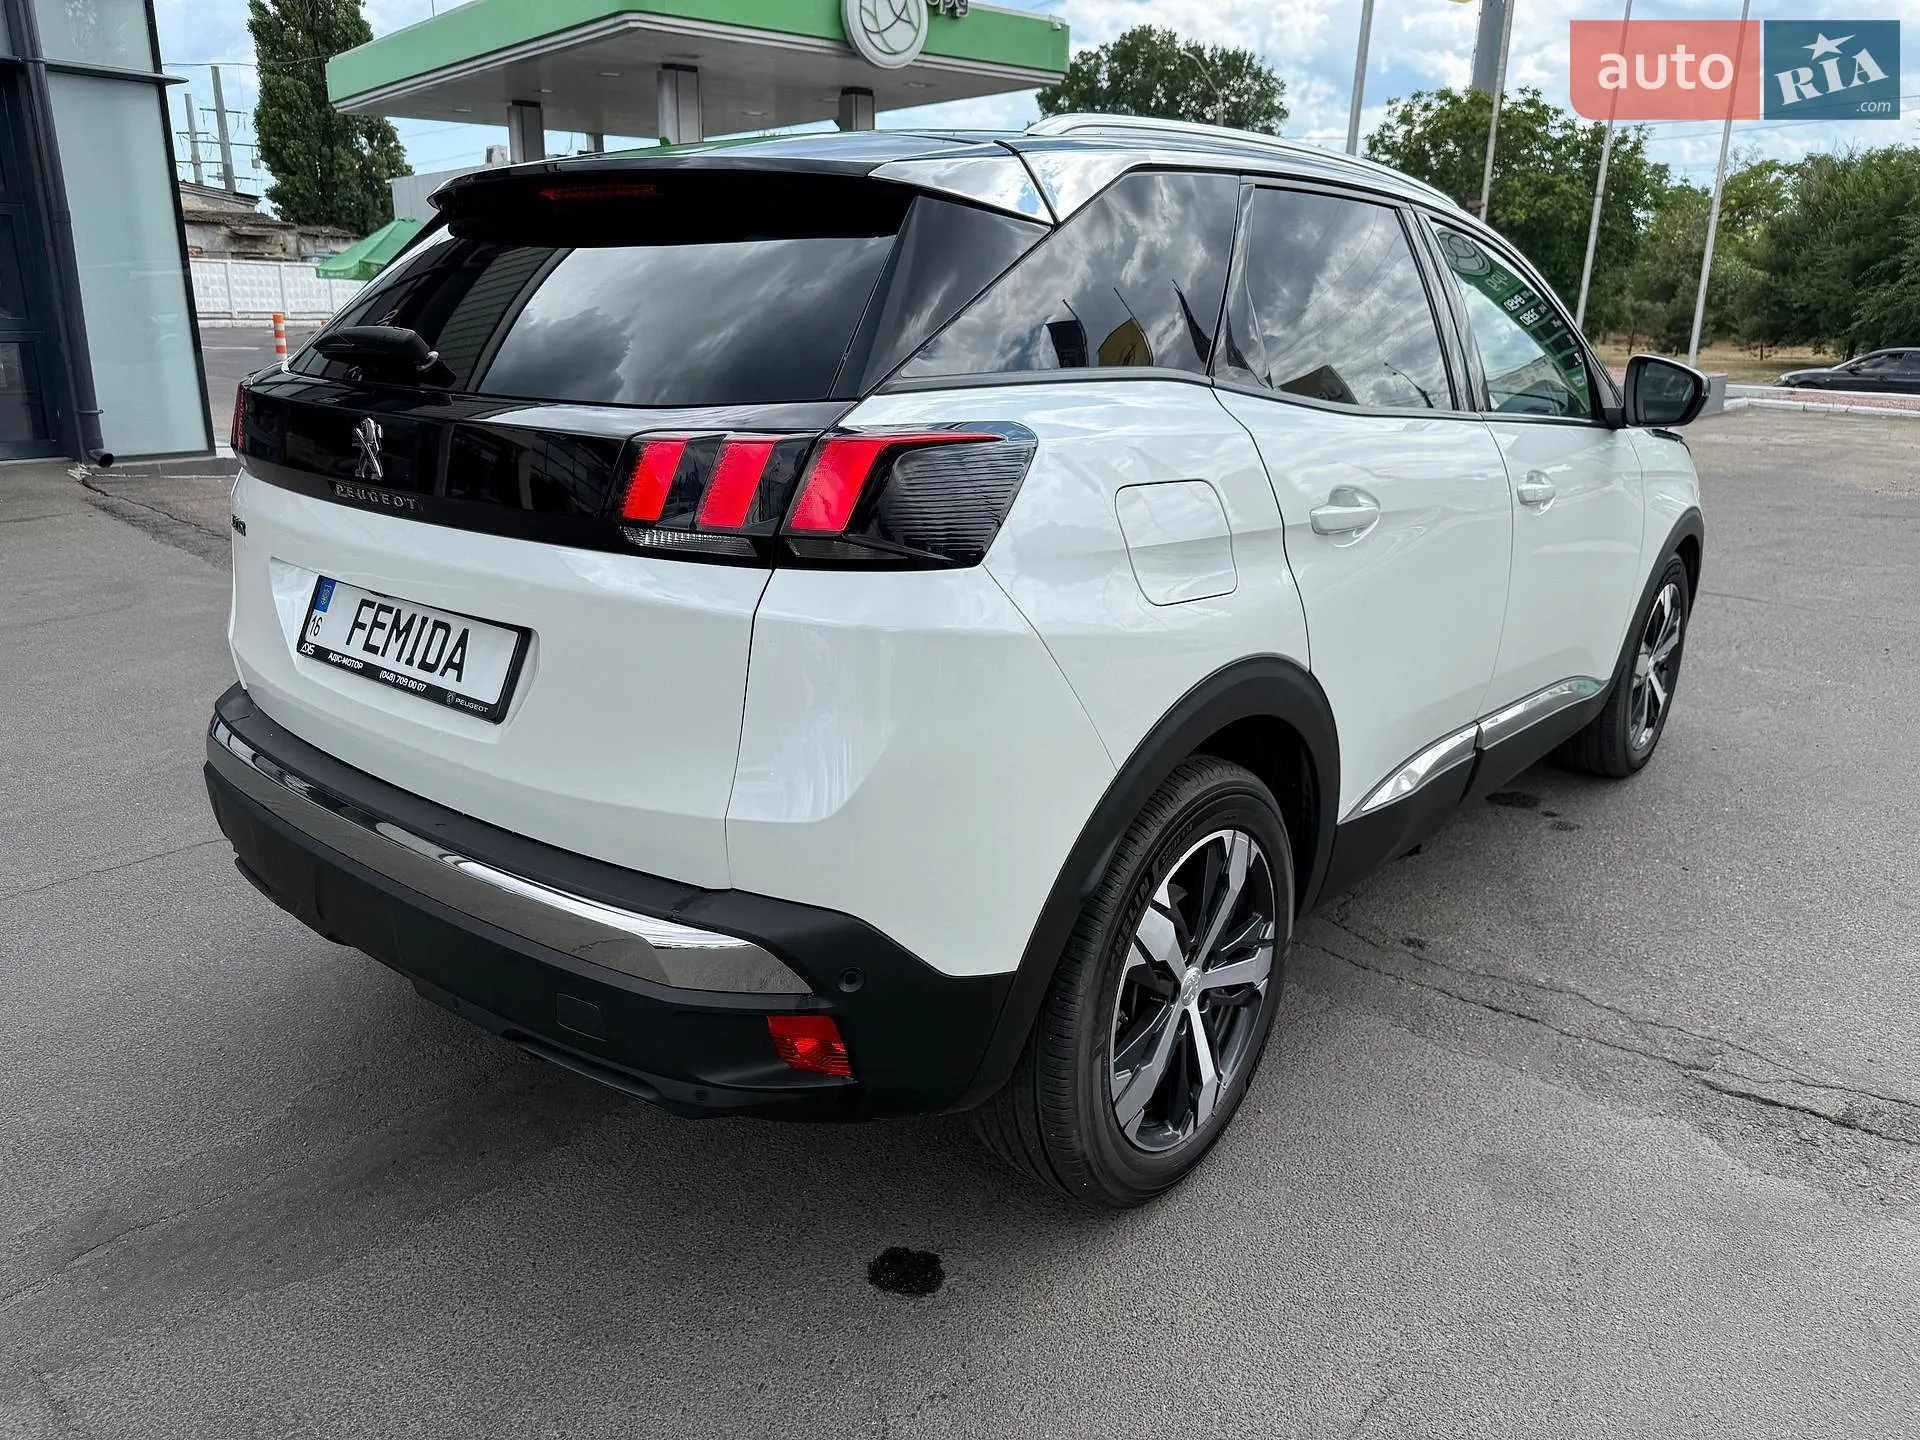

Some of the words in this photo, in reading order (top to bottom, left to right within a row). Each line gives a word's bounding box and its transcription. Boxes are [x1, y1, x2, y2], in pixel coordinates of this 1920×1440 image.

[335, 484, 416, 510] PEUGEOT
[309, 615, 323, 636] 16
[346, 598, 469, 683] FEMIDA
[380, 670, 396, 684] (048)
[396, 675, 408, 686] 709
[408, 680, 417, 689] 00
[417, 682, 427, 692] 07
[455, 697, 489, 713] PEUGEOT
